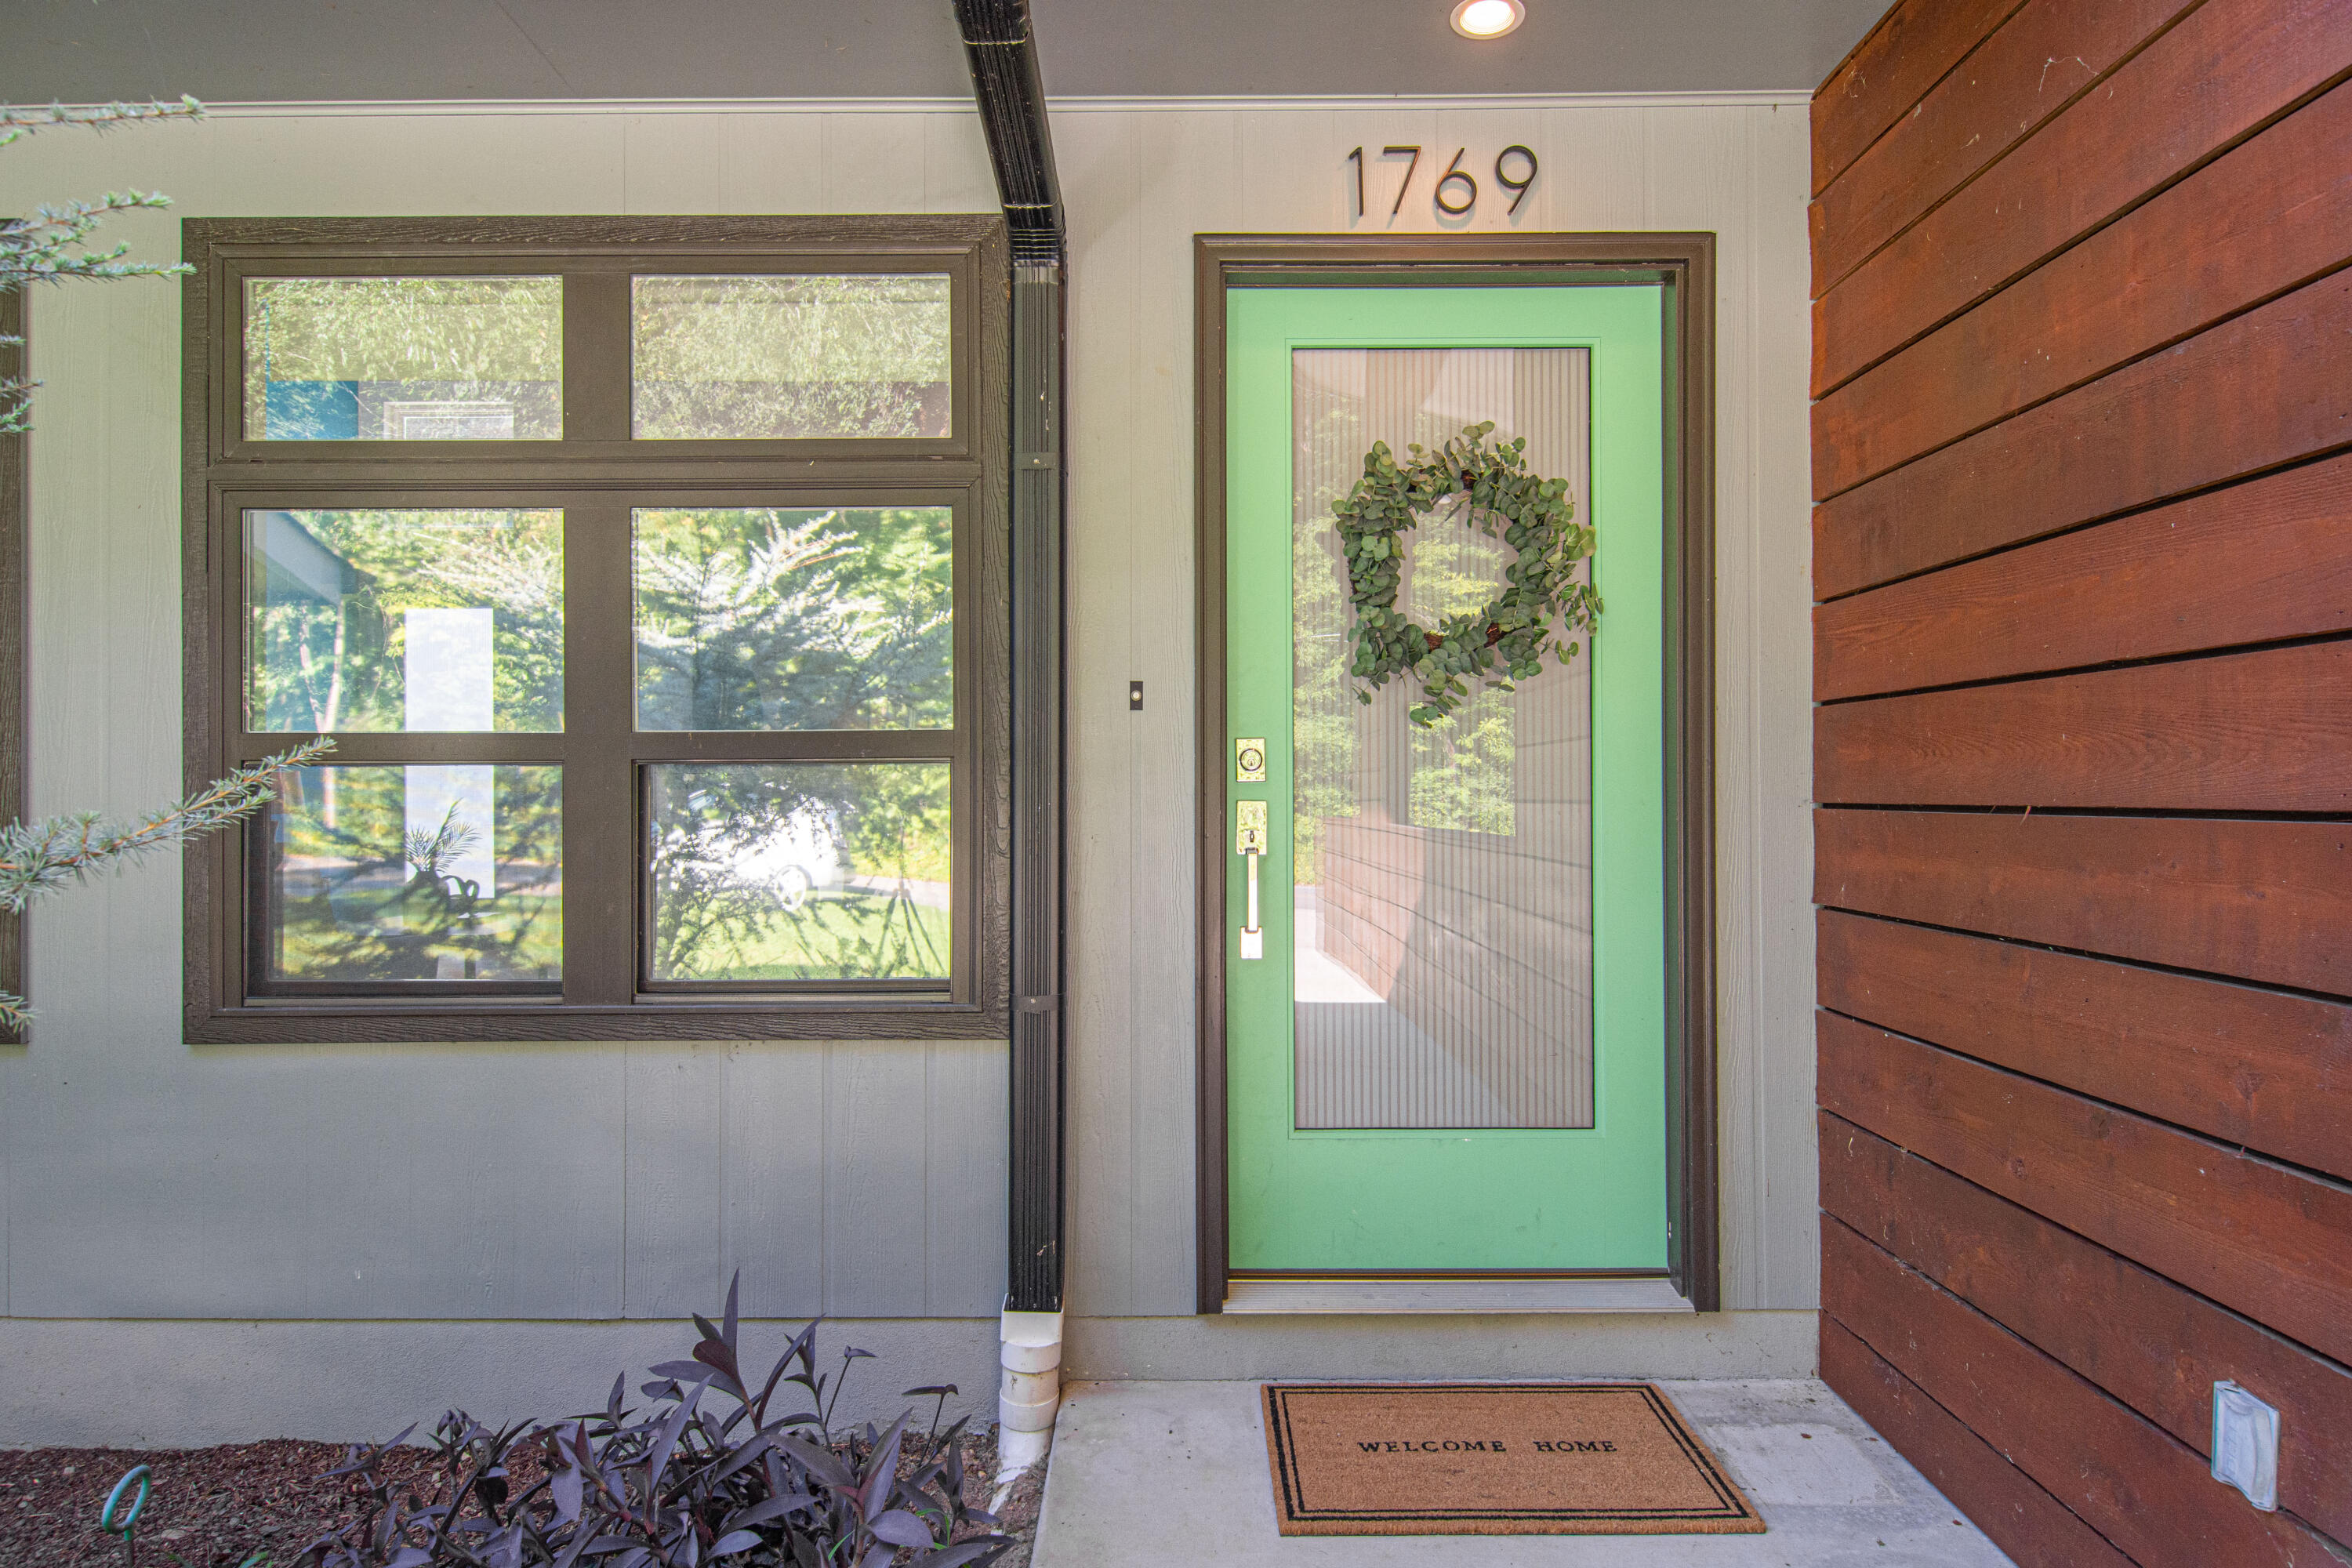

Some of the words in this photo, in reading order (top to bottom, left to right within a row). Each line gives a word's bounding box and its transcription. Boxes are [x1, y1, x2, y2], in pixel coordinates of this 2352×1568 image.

[1348, 144, 1538, 216] 1769
[1357, 1440, 1508, 1453] WELCOME
[1533, 1440, 1618, 1453] HOME
